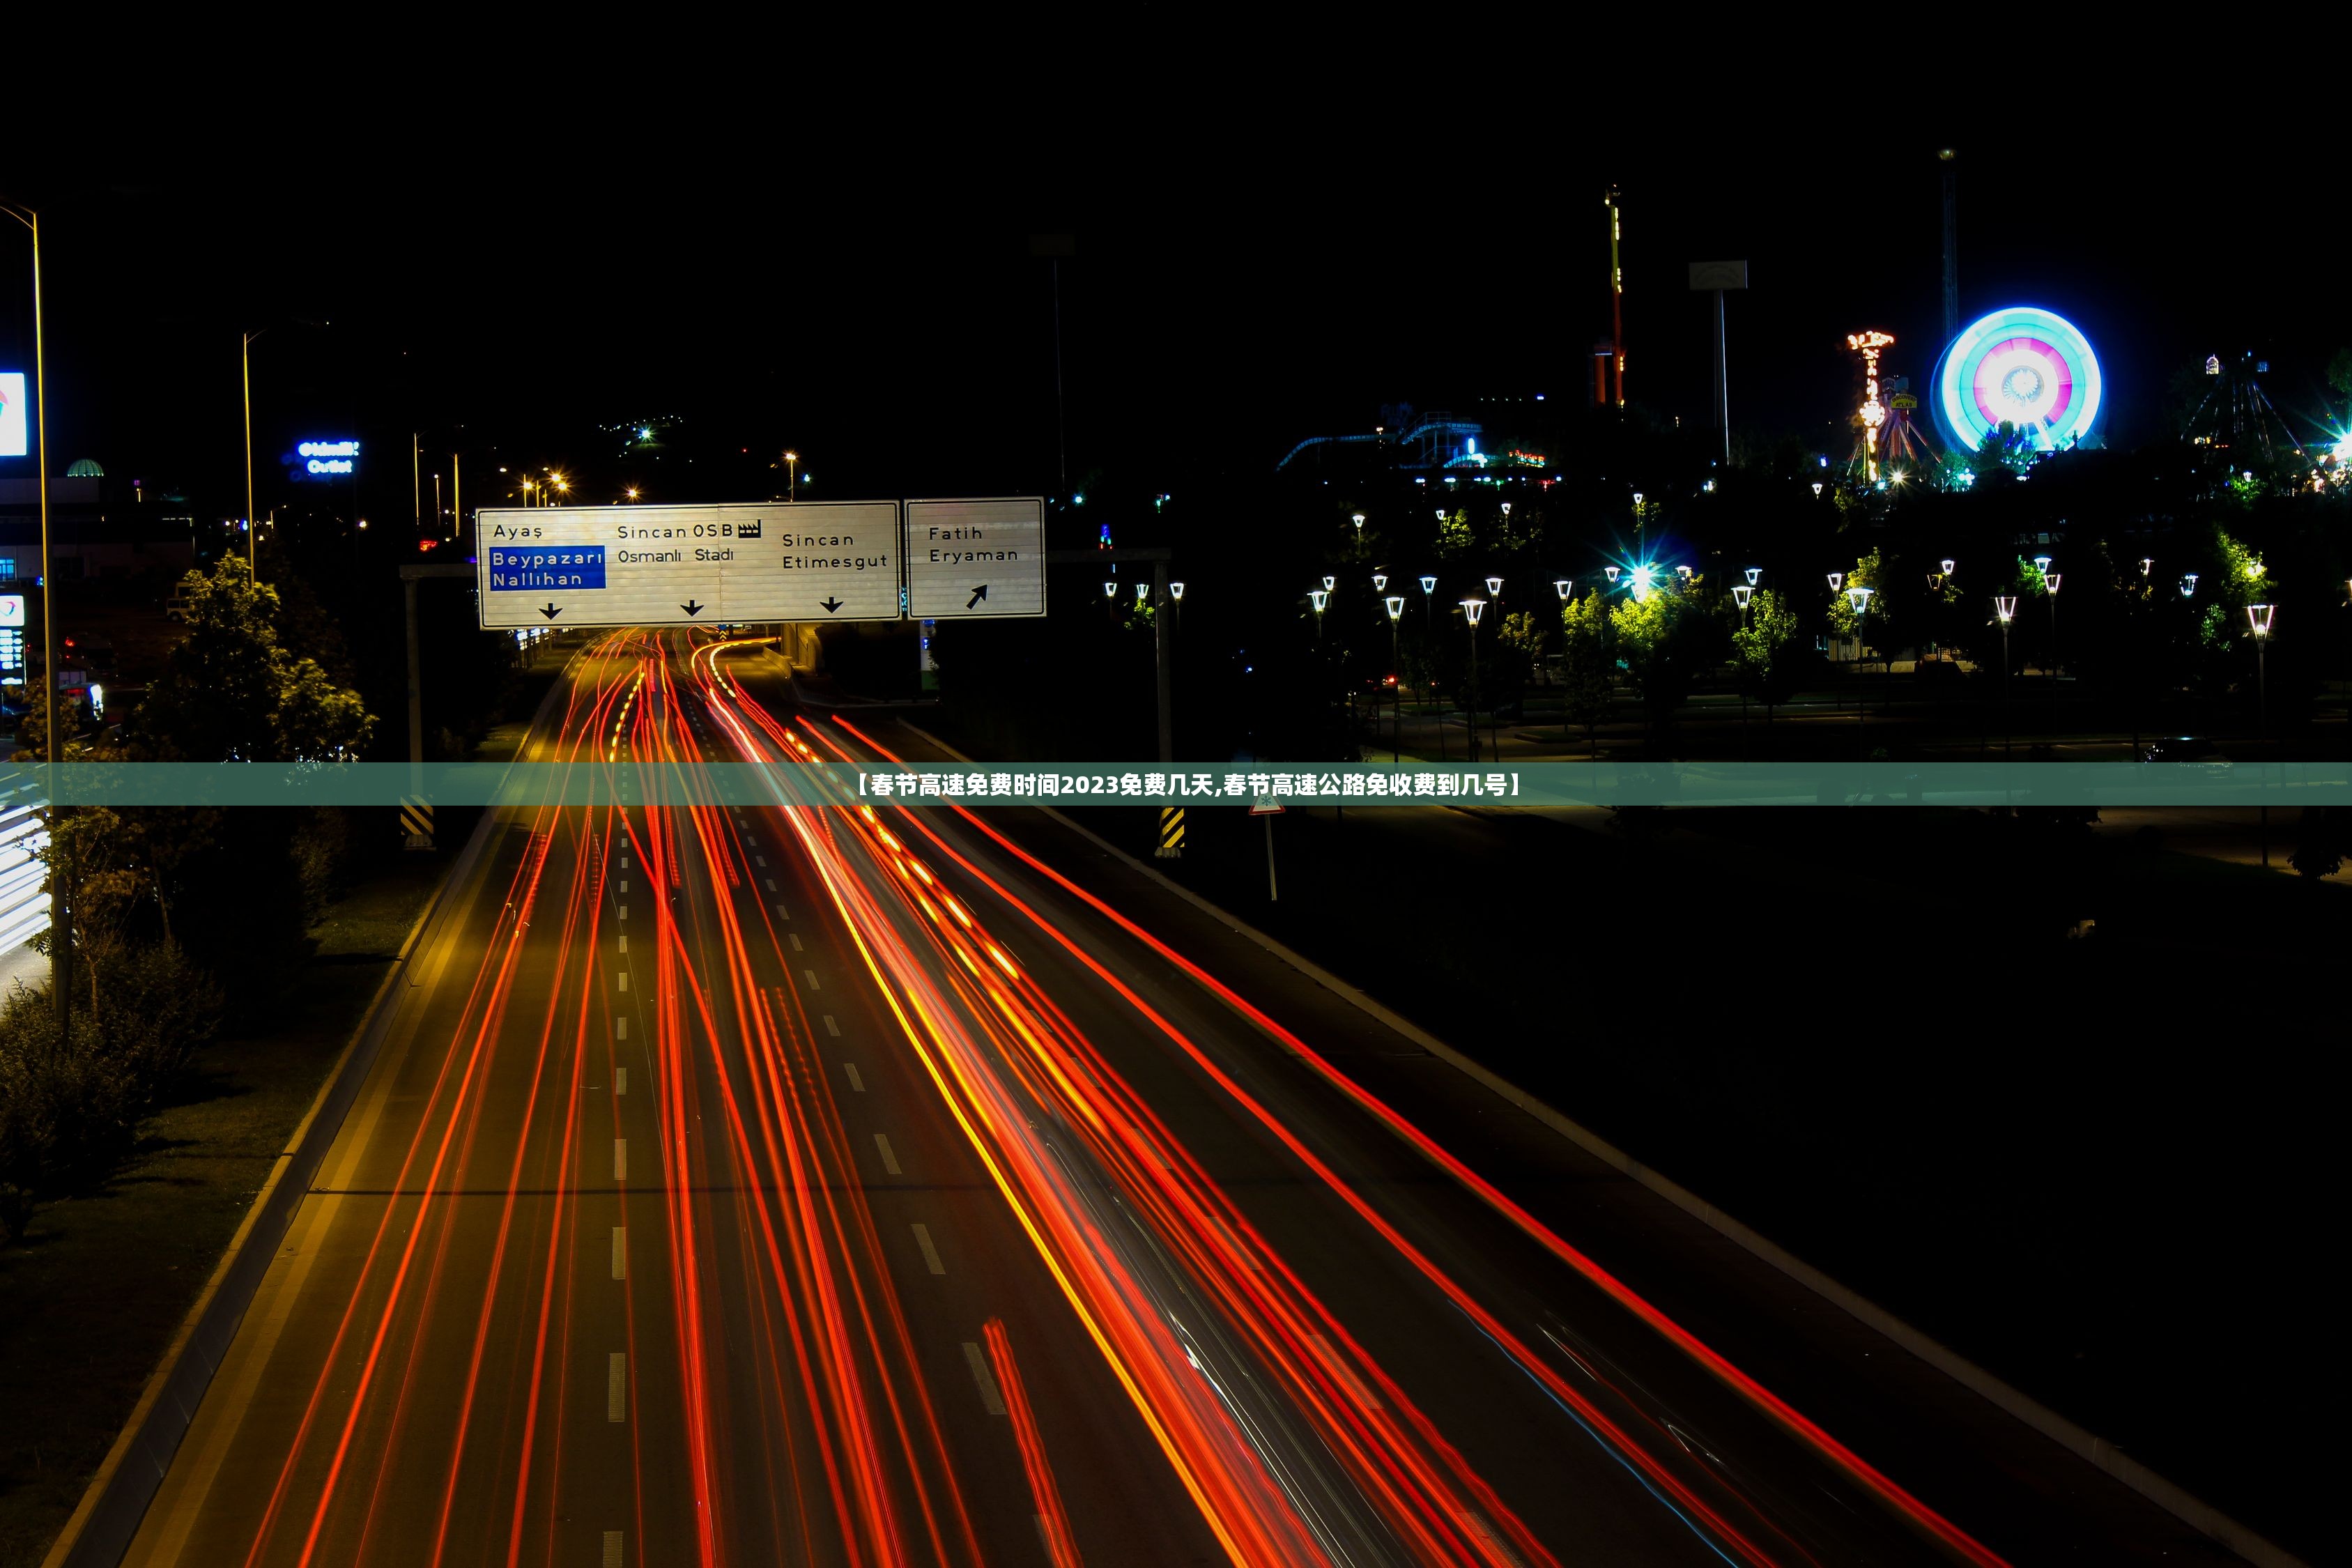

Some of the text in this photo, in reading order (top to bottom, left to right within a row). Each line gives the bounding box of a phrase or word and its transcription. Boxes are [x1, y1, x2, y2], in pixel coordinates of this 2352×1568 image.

[493, 524, 542, 541] Ayaş
[618, 524, 733, 539] Sincan OSB
[929, 526, 983, 540] Fatih
[783, 534, 854, 547] Sincan
[493, 552, 601, 569] Beypazarı
[618, 548, 734, 563] Osmanlı Stadı
[783, 555, 887, 571] Etimesgut
[930, 549, 1017, 565] Eryaman
[493, 573, 581, 586] Nallıhan
